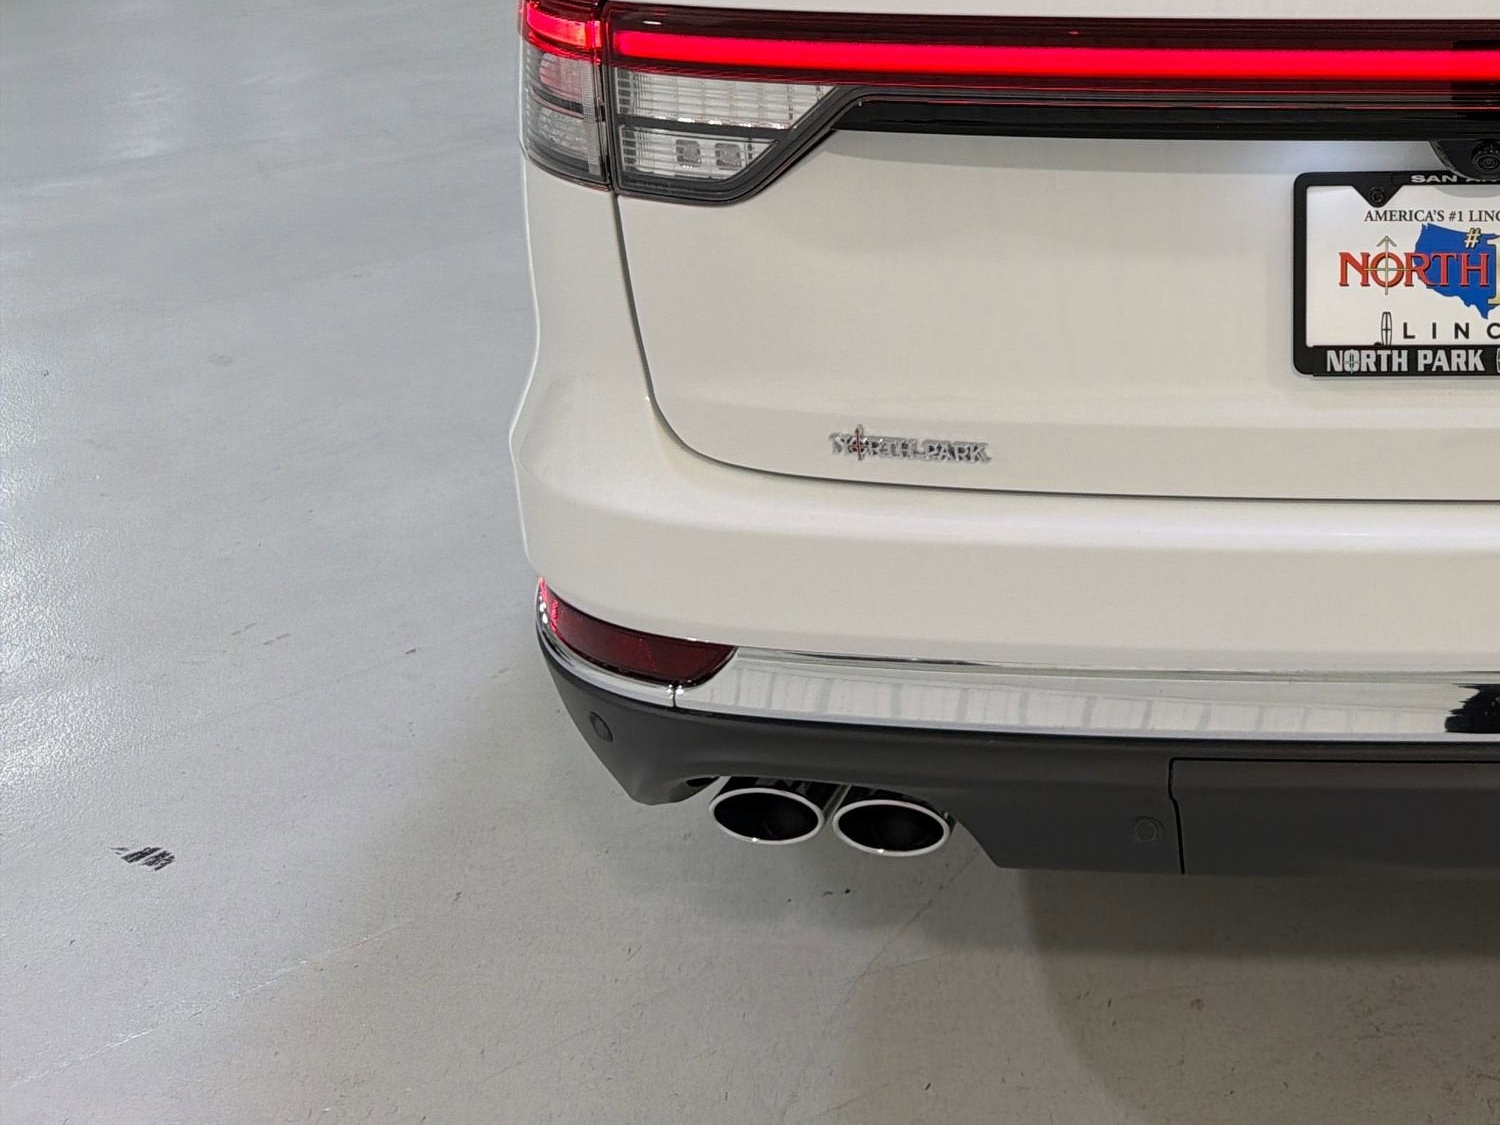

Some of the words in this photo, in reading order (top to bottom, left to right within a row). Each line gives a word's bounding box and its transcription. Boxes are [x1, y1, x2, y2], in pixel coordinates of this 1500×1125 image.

[1411, 174, 1457, 183] SAN
[1364, 210, 1445, 223] AMERICA'S
[1448, 211, 1463, 222] #1
[1338, 251, 1490, 288] NORTH
[1326, 349, 1404, 372] NORTH
[1417, 349, 1485, 372] PARK
[921, 439, 992, 463] PARK
